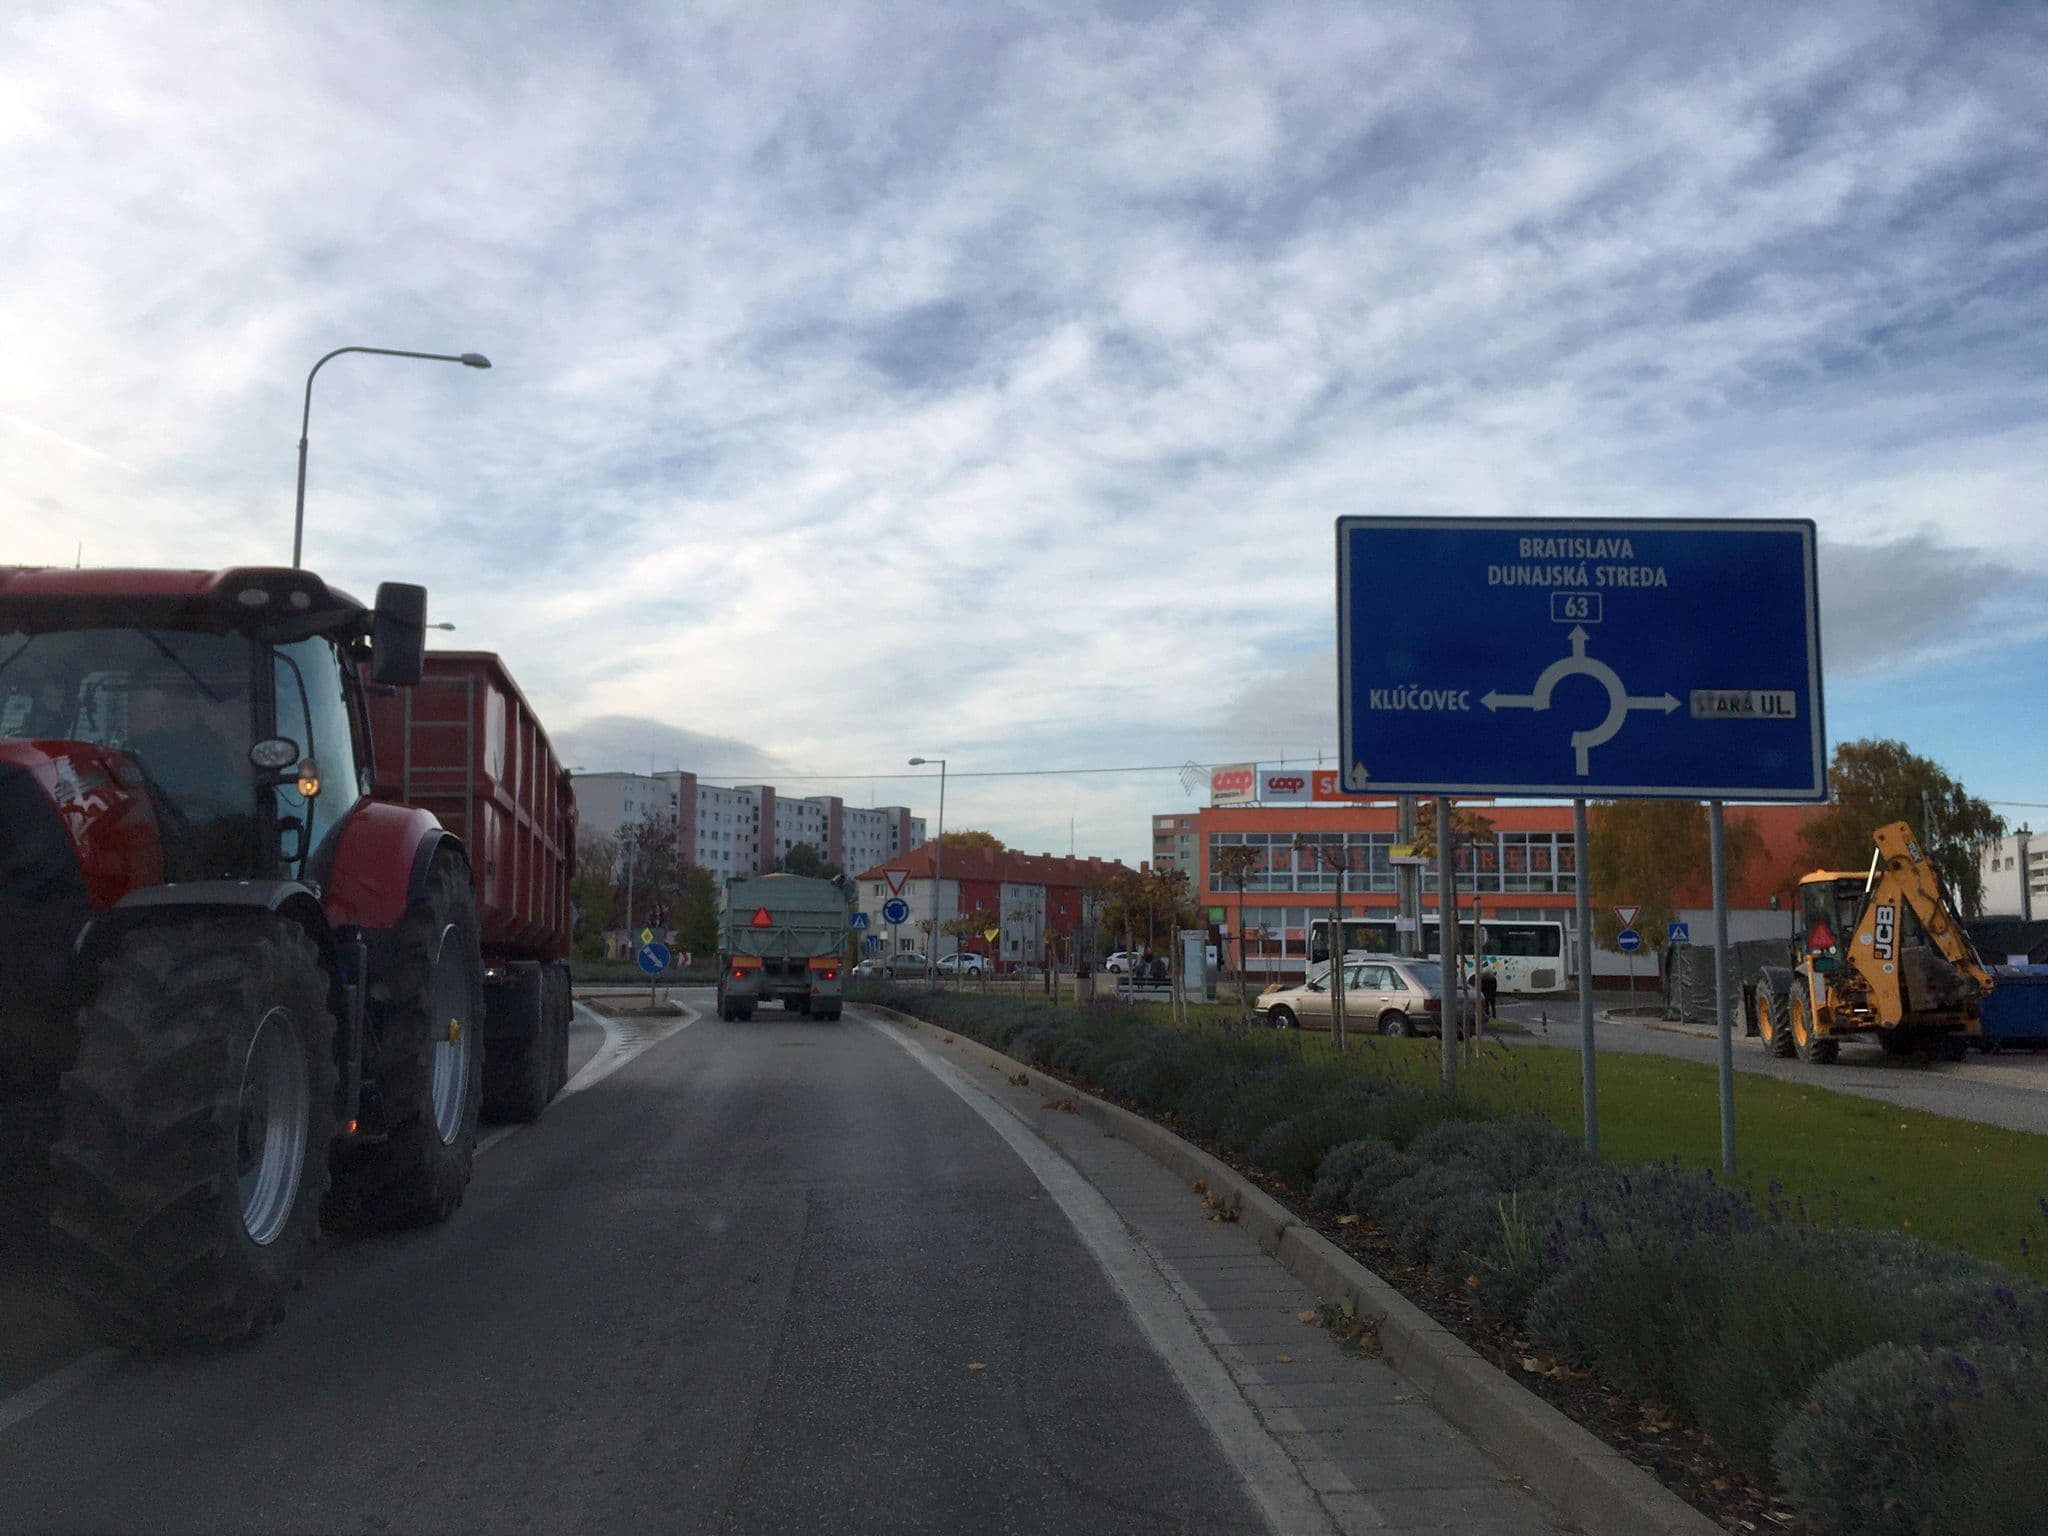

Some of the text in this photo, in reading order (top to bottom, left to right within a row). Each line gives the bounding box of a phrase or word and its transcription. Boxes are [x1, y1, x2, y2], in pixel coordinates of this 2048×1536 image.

[1519, 537, 1634, 559] BRATISLAVA
[1488, 561, 1668, 588] DUNAJSKÁ STREDA
[1564, 596, 1589, 619] 63
[1268, 777, 1305, 795] coop
[1874, 906, 1894, 960] JCB
